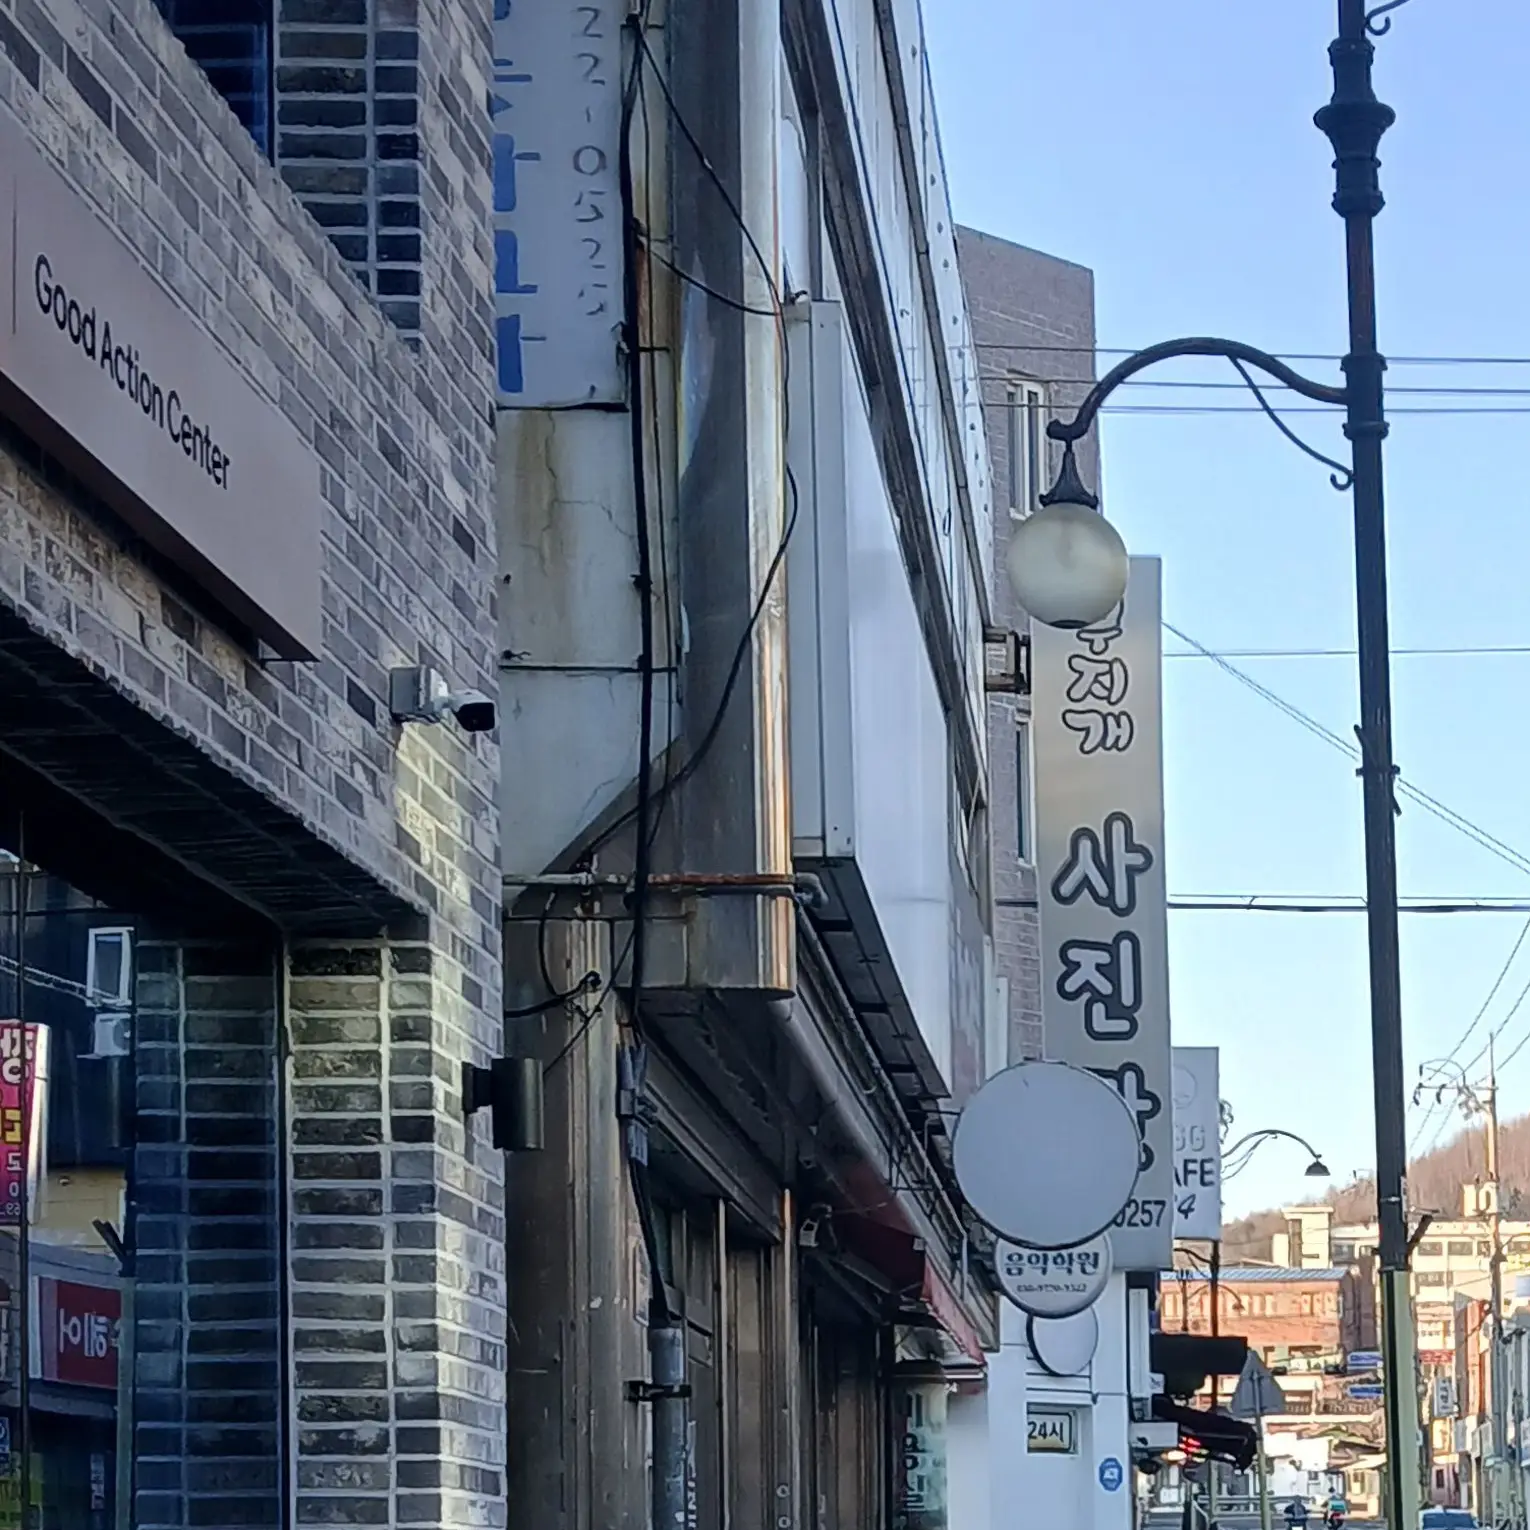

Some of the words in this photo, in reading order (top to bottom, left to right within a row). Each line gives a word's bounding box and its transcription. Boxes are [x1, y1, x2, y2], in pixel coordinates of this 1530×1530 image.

[36, 255, 96, 360] Good
[101, 321, 164, 428] Action
[167, 390, 229, 489] Center
[1004, 1251, 1100, 1276] 음악학원
[1027, 1420, 1065, 1443] 24시
